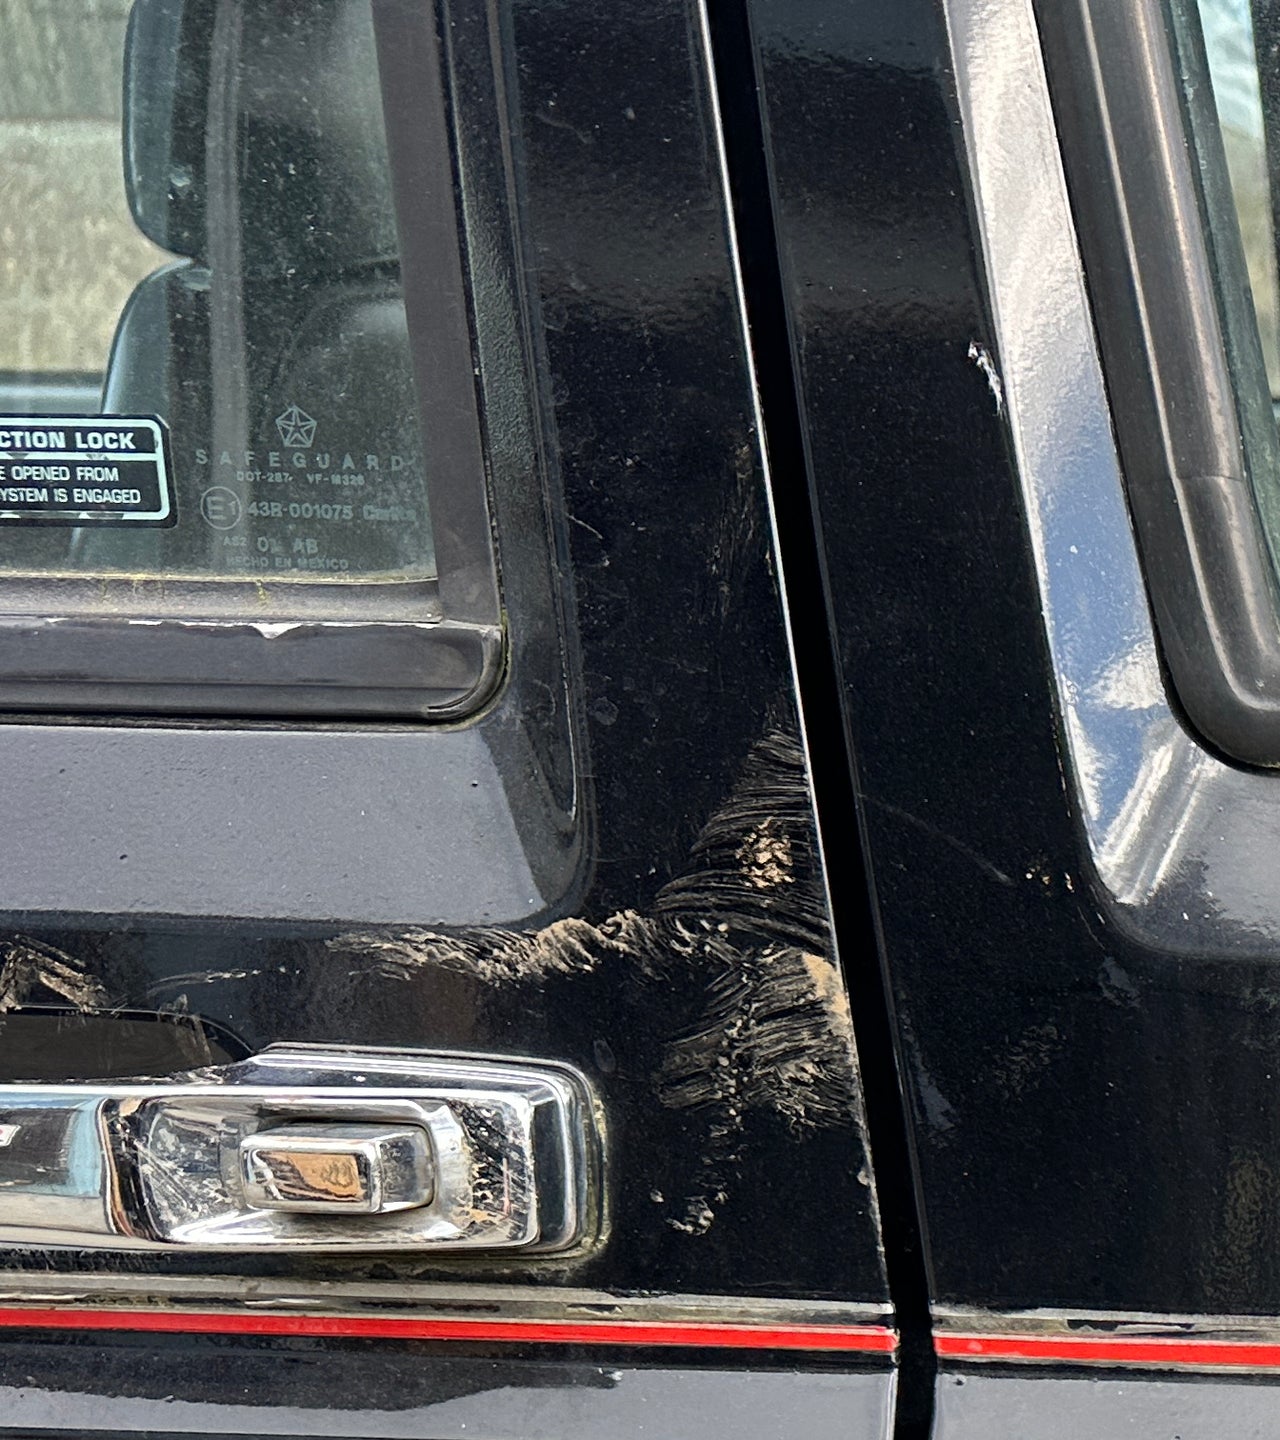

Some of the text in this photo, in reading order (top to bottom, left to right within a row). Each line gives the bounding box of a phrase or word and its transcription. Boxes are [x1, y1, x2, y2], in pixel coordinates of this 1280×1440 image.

[75, 432, 136, 450] LOCK
[196, 449, 403, 471] SAFEGUARD
[11, 466, 71, 482] OPENED
[76, 467, 119, 482] FROM
[54, 488, 68, 503] IS
[73, 489, 141, 504] ENGAGED
[275, 557, 292, 568] EN
